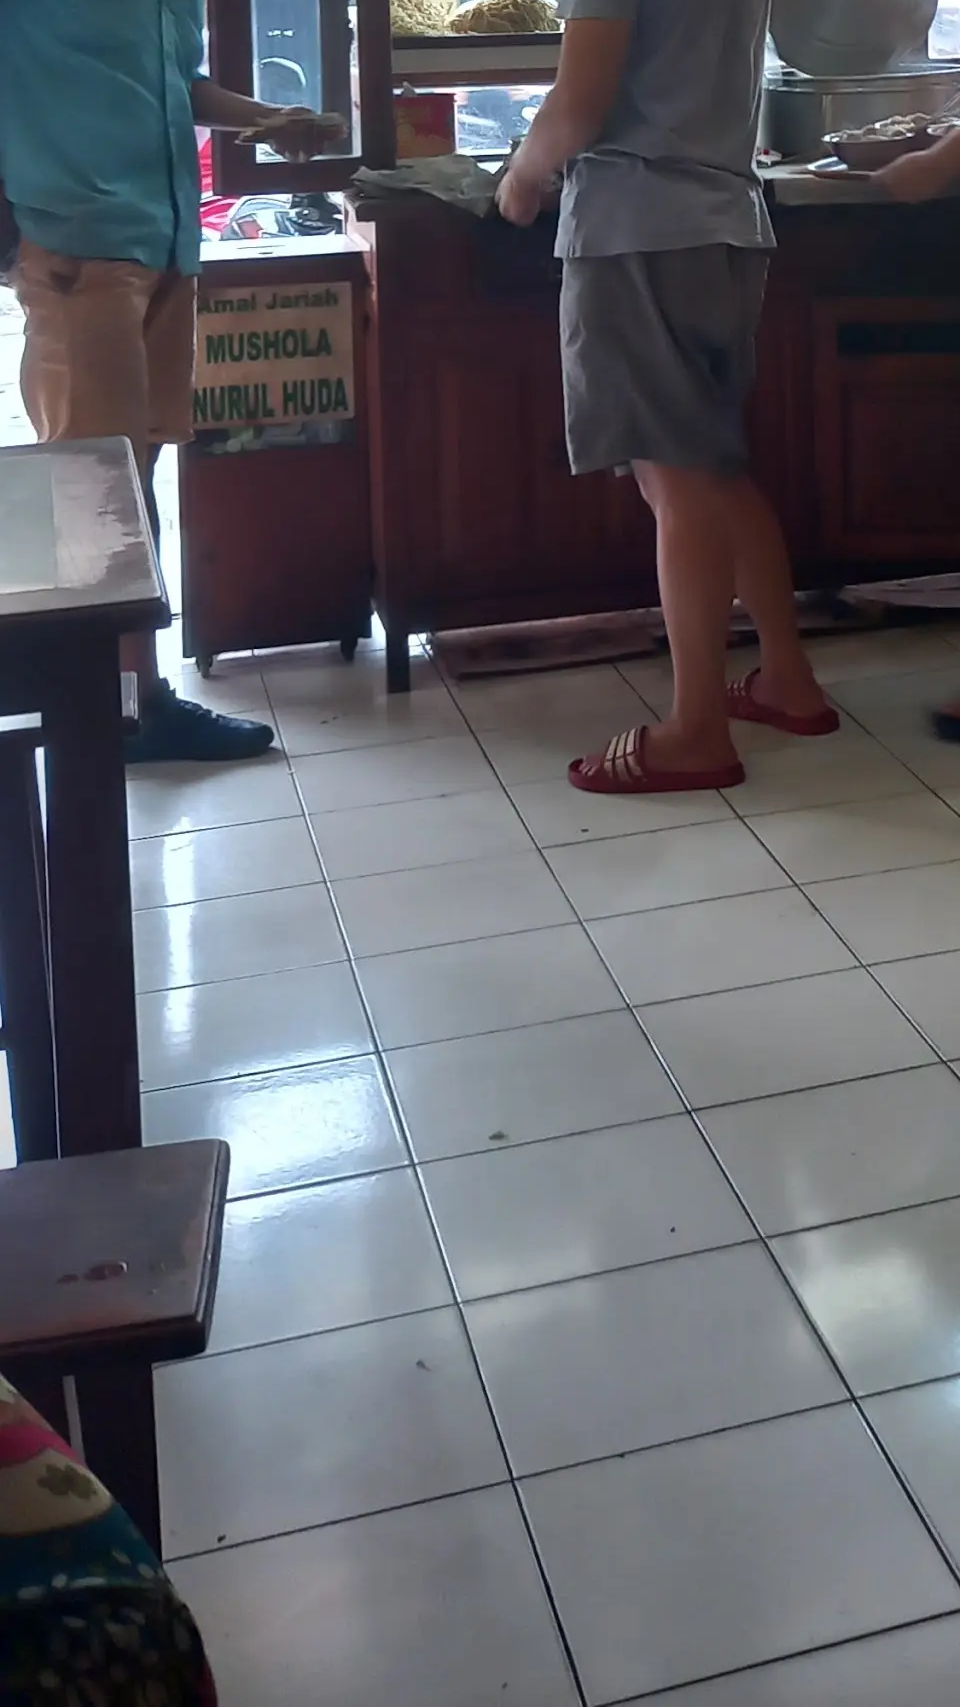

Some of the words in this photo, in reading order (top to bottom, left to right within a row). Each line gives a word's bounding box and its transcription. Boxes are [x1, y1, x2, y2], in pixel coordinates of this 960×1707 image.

[264, 288, 339, 311] Jariah
[206, 328, 332, 365] MUSHOLA
[193, 382, 275, 423] NURUL
[282, 376, 349, 417] HUDA
